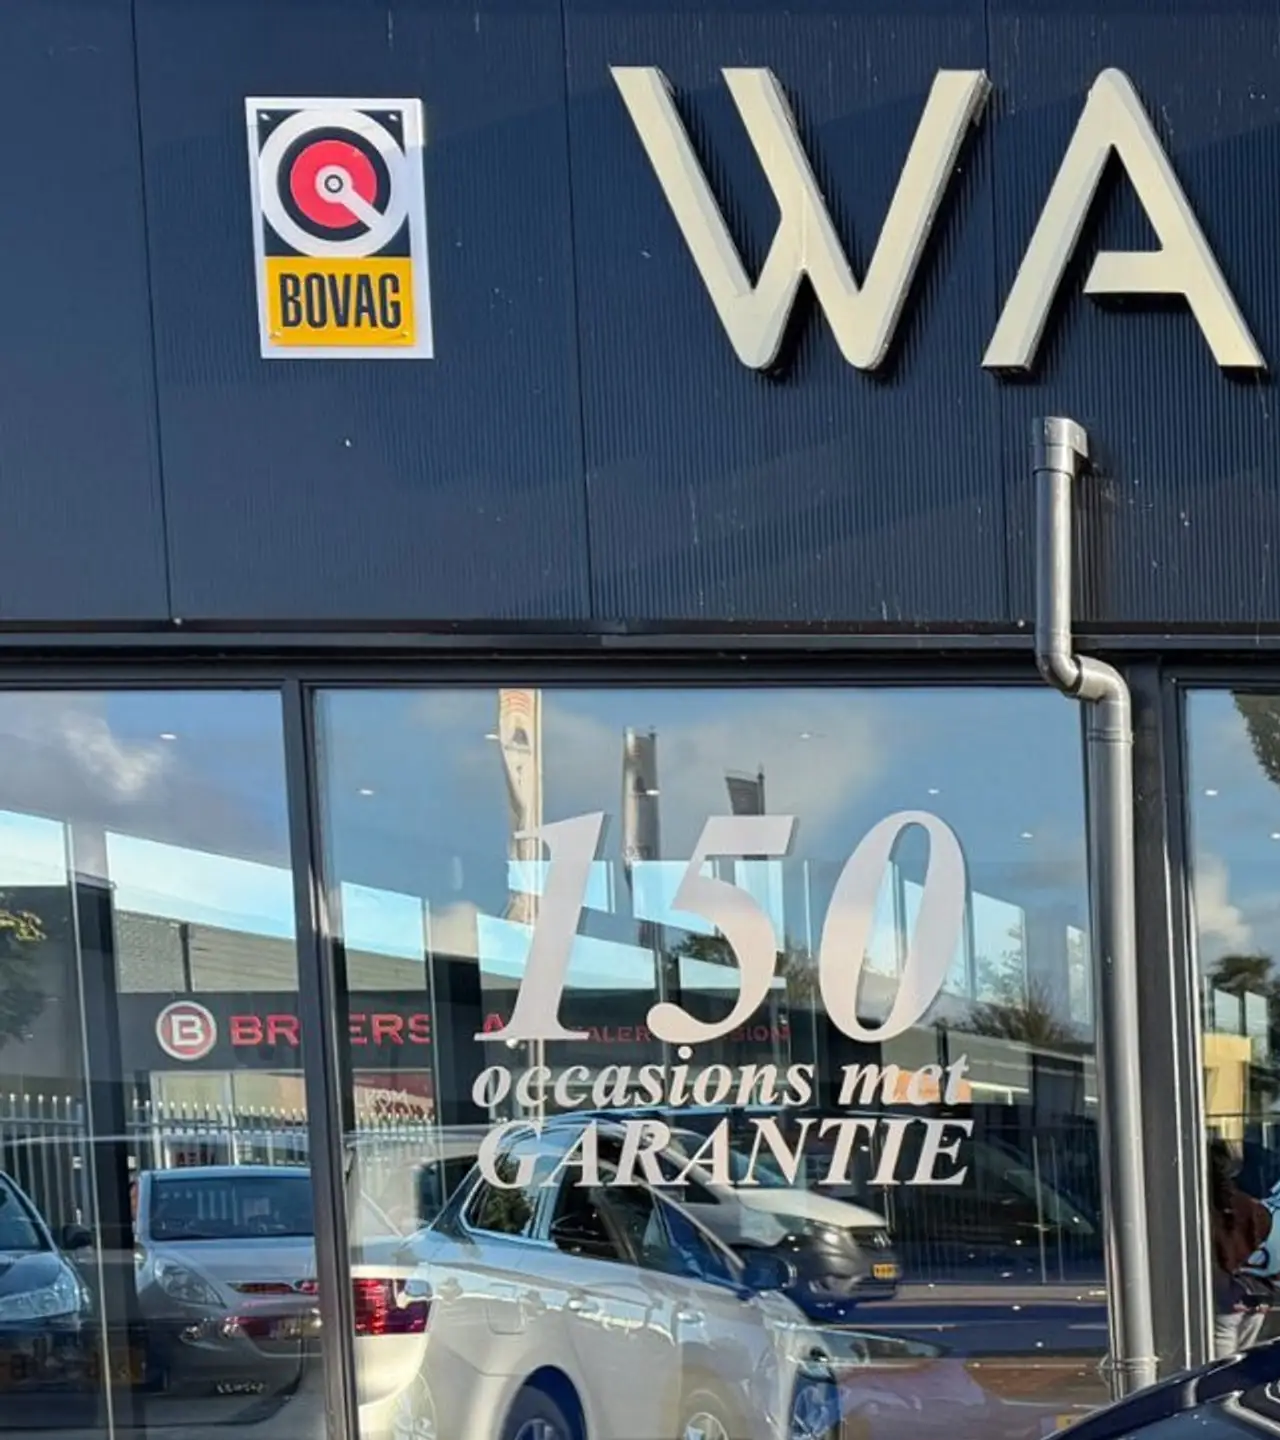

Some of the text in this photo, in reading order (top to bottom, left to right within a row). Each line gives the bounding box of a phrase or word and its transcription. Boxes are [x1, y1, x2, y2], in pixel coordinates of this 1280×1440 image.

[279, 271, 402, 330] BOVAG
[474, 809, 970, 1043] 150
[229, 1013, 432, 1047] BRERS
[471, 1044, 971, 1108] occasions met
[477, 1116, 975, 1190] GARANTIE
